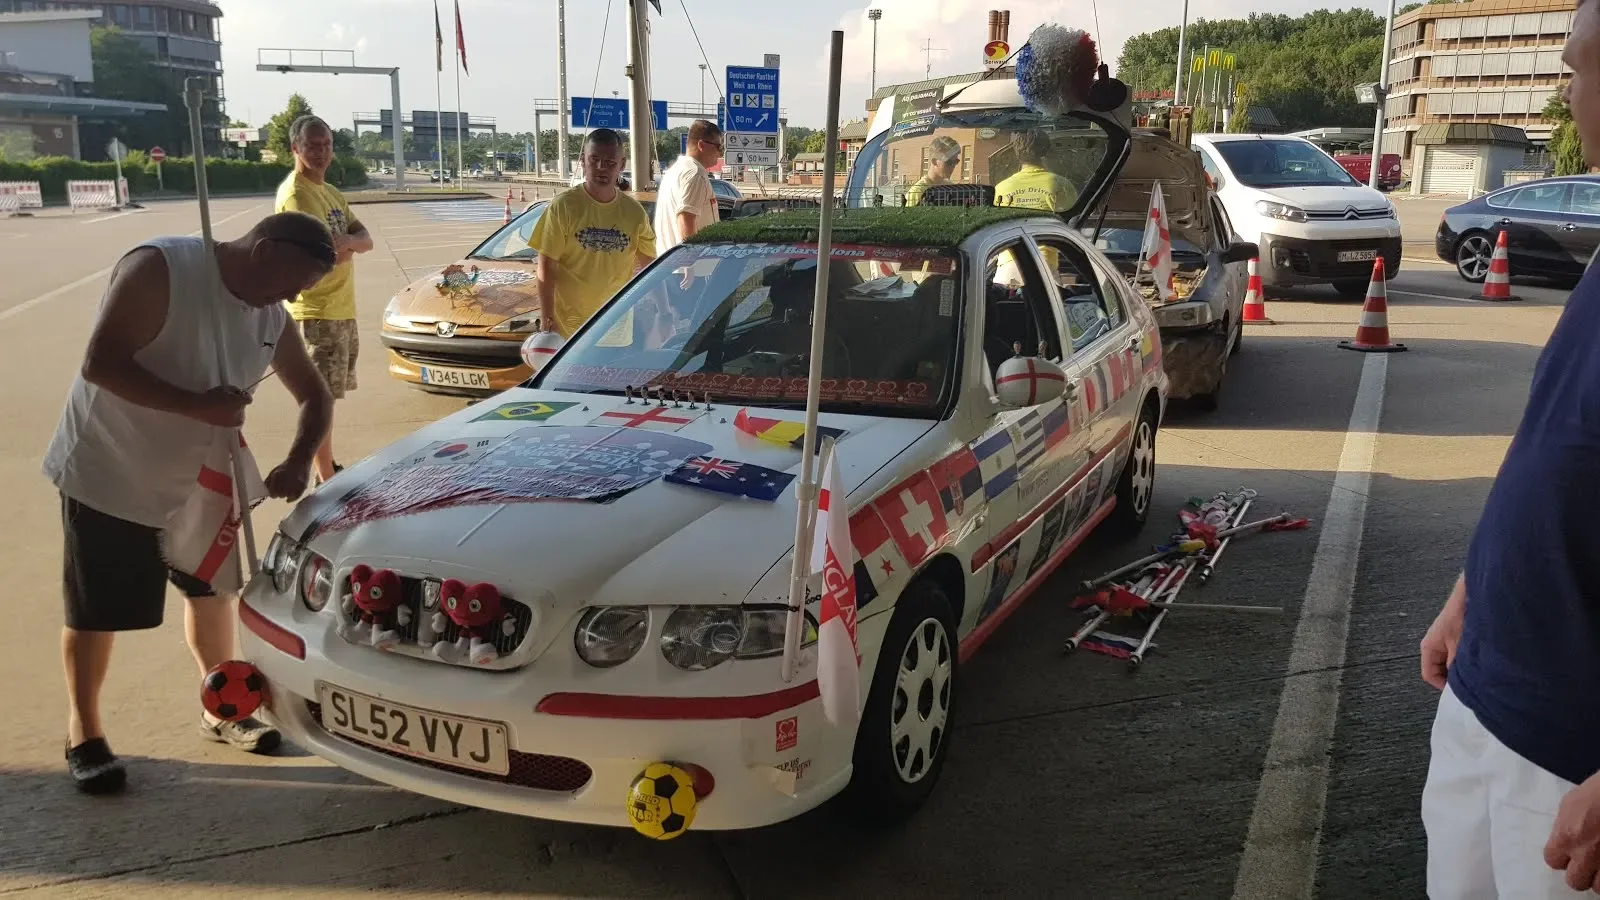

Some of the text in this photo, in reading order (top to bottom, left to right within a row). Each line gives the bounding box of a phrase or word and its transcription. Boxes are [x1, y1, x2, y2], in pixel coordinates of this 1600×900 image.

[729, 71, 777, 81] Deutscher Rasthof
[733, 81, 745, 89] Weil
[757, 82, 773, 90] Rhein
[735, 115, 745, 123] 80
[758, 154, 769, 163] km
[784, 247, 865, 257] Barclona
[428, 369, 487, 387] V345 LGK
[331, 691, 491, 764] SL52 VYJ
